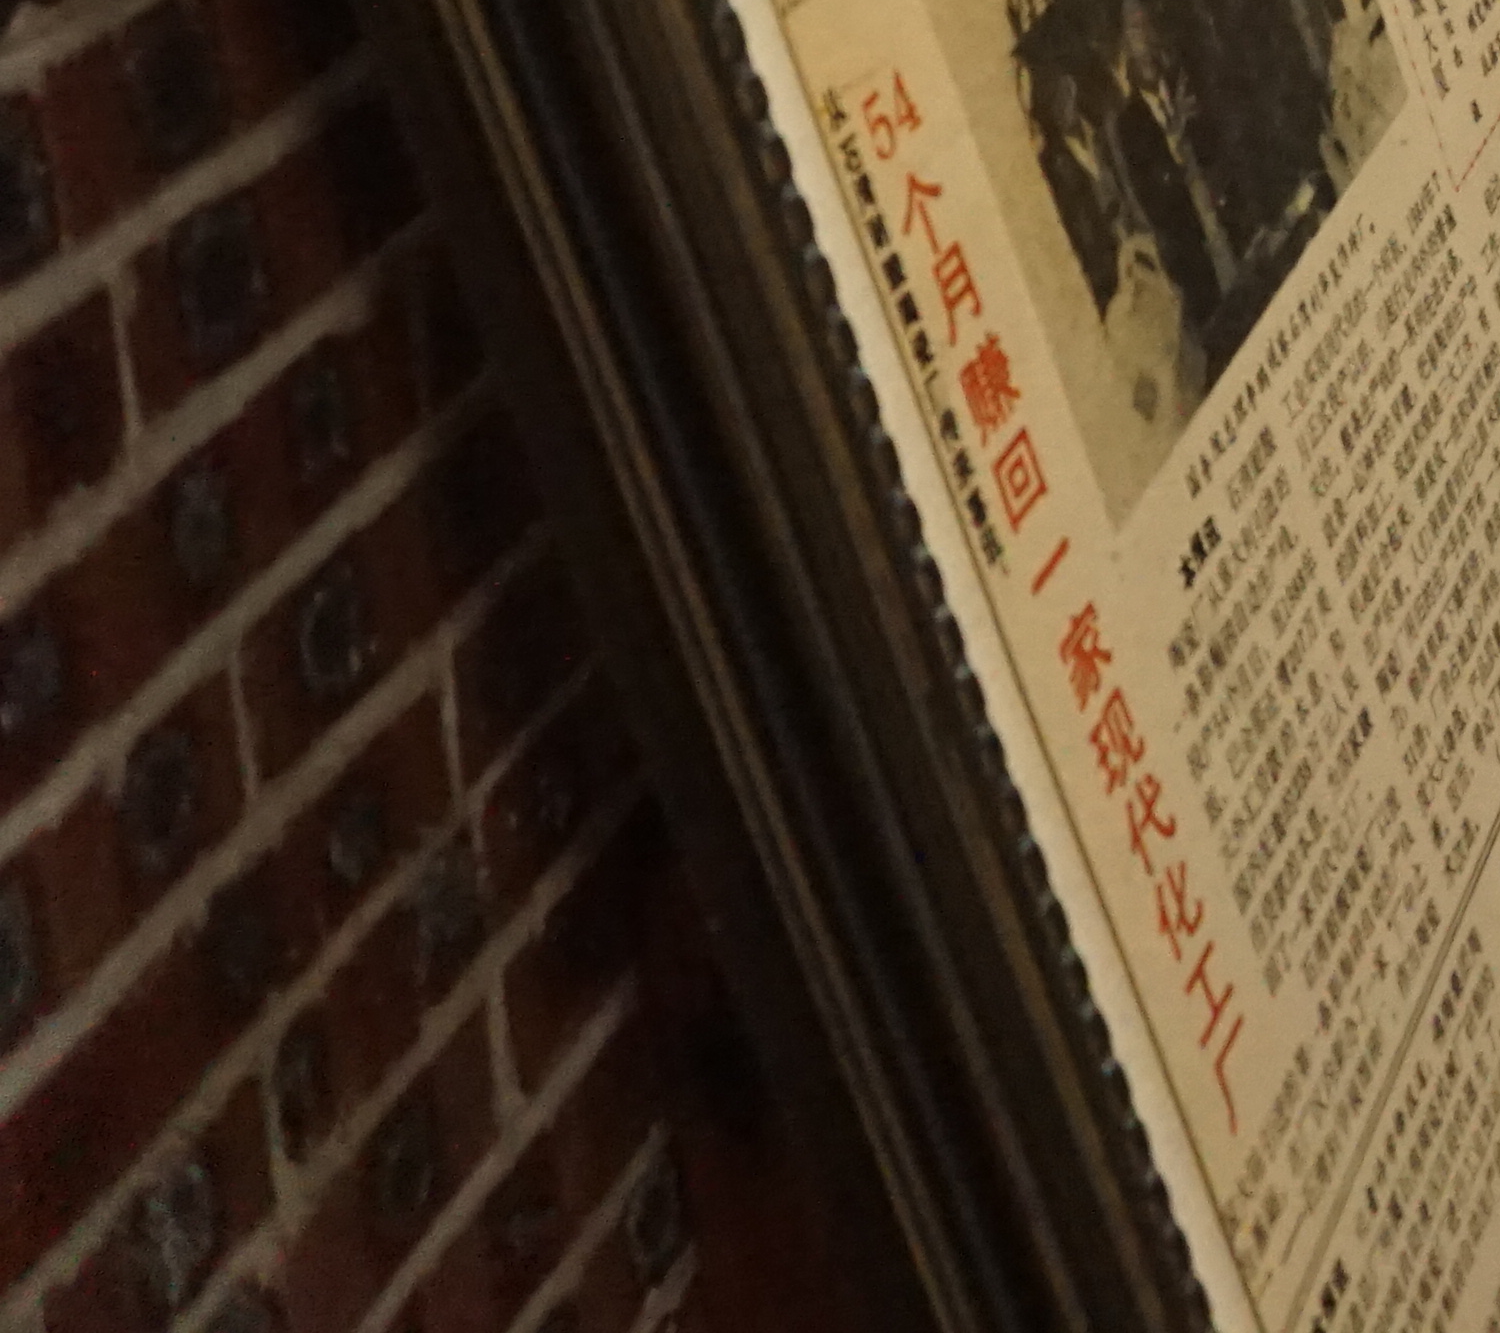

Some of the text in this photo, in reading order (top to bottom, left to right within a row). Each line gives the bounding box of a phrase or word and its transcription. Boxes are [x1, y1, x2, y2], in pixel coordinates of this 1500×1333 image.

[860, 68, 1247, 1135] 54个月赚回一家现代化工厂
